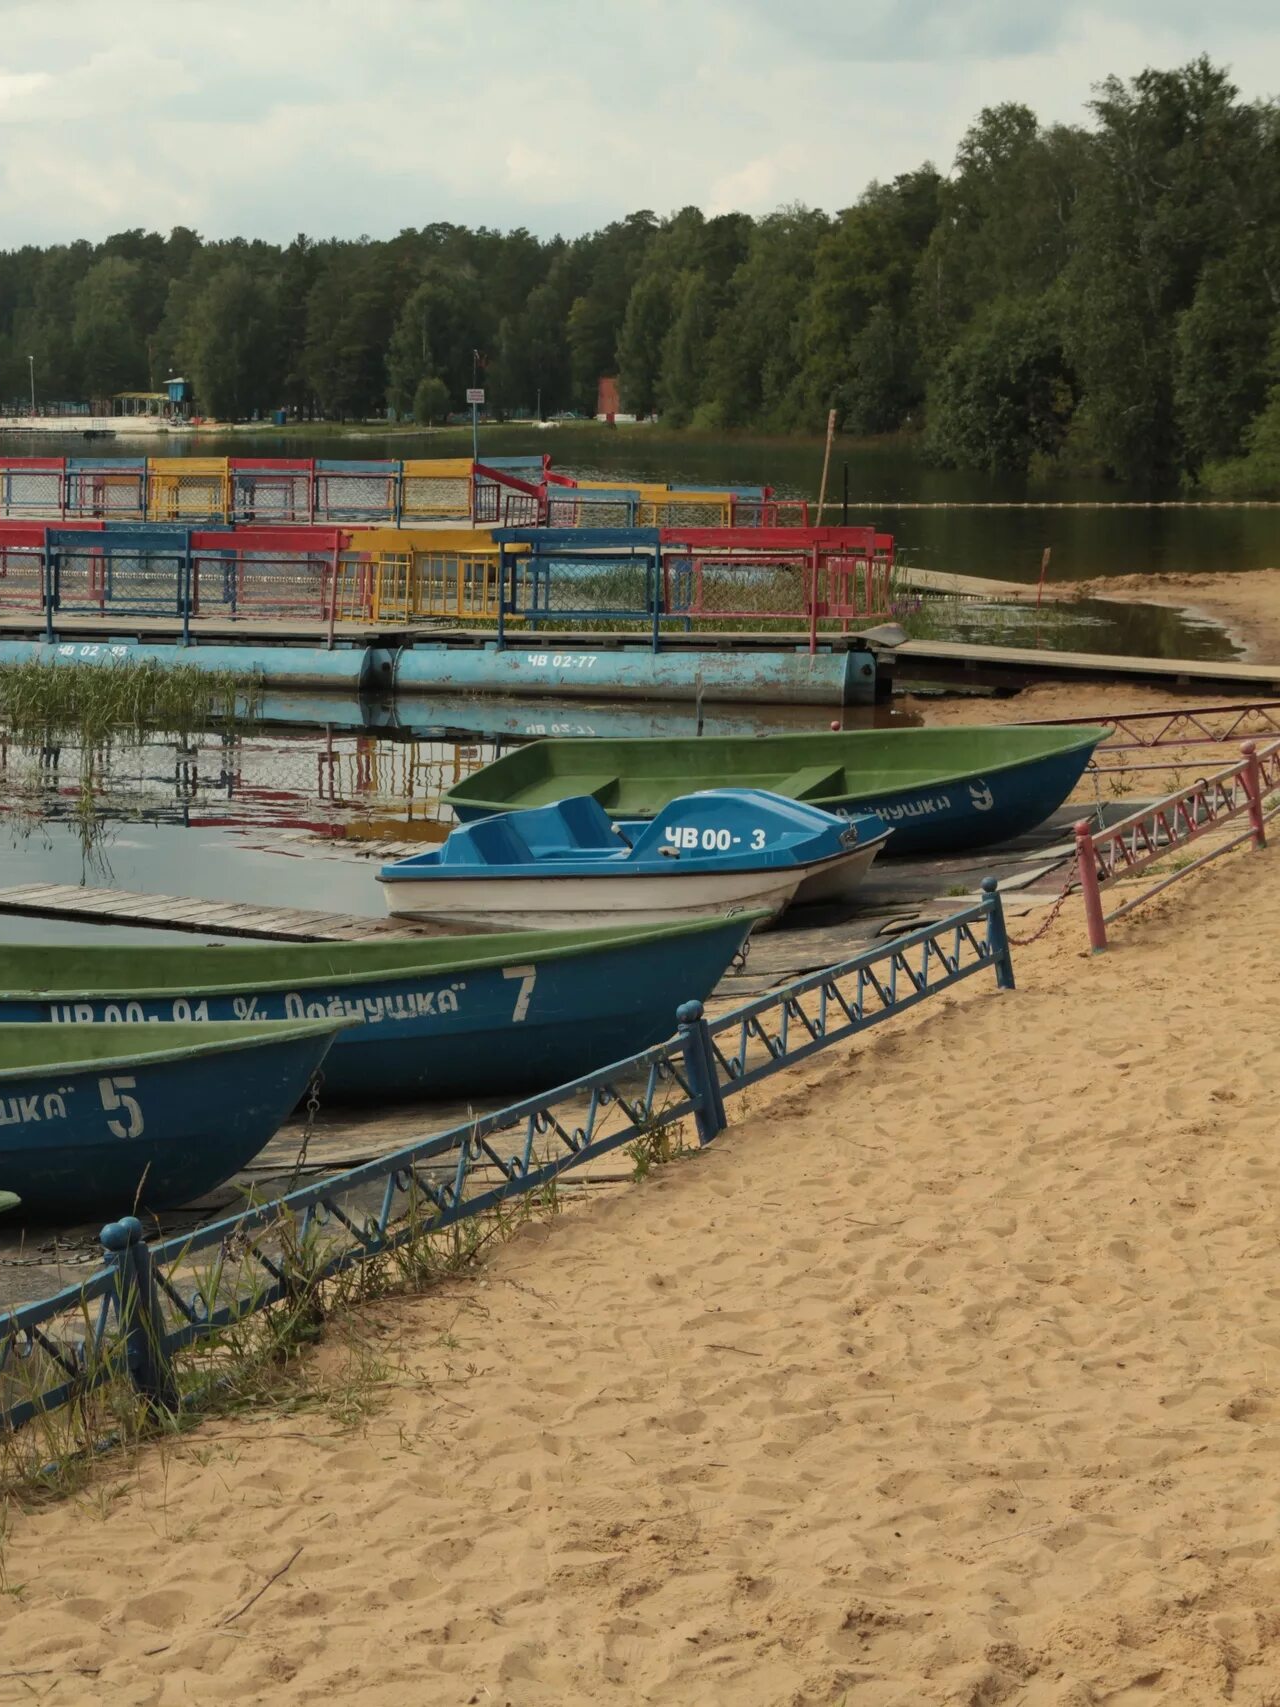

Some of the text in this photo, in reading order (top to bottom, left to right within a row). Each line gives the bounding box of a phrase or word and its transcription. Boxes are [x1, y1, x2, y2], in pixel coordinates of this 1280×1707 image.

[527, 654, 598, 669] ЧВ 02-77
[664, 826, 699, 849] ЧВ
[502, 965, 537, 1022] 7
[99, 1076, 145, 1138] 5
